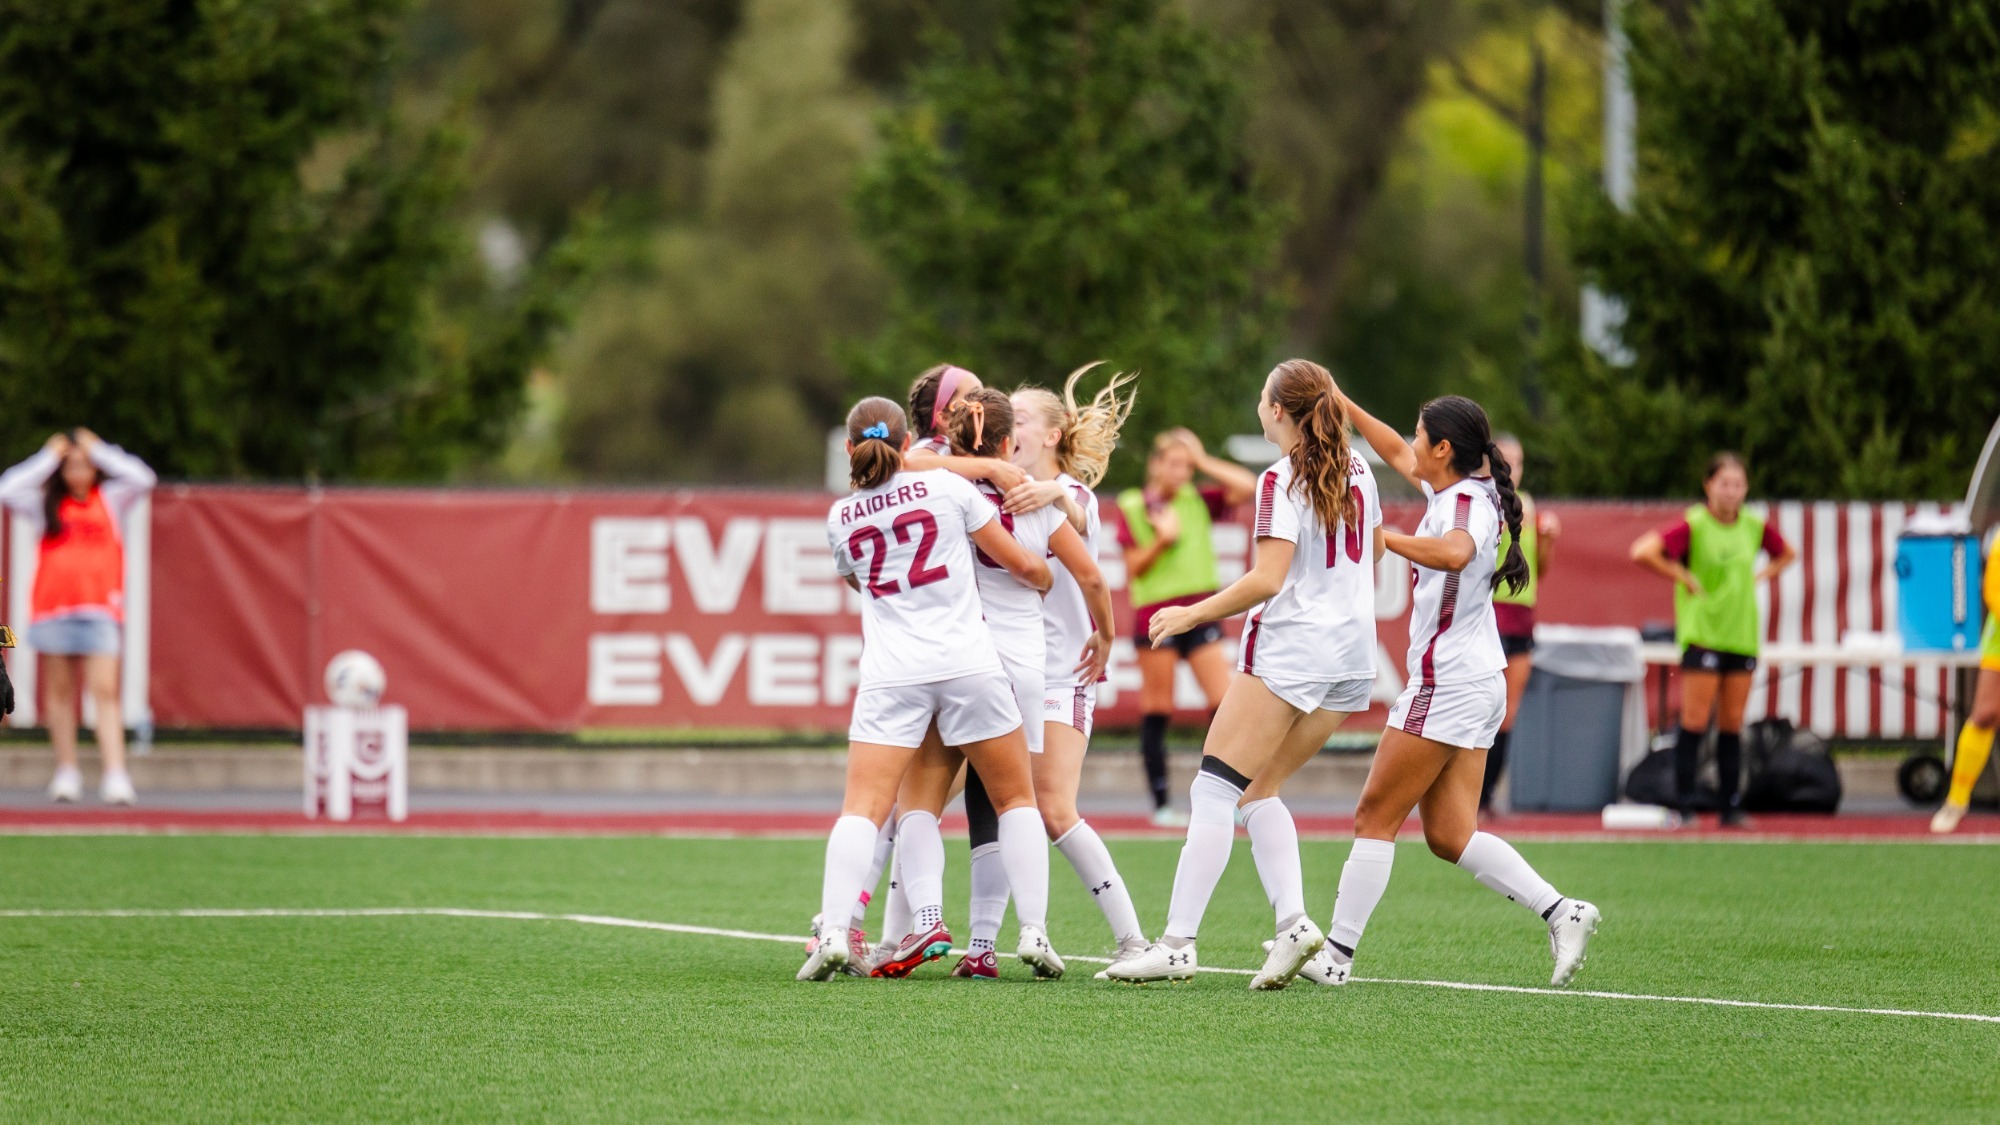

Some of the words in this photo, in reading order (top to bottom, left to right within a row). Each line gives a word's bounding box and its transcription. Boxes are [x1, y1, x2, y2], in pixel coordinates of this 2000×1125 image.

[841, 481, 928, 526] RAIDERS
[590, 517, 862, 615] EVE
[848, 508, 950, 599] 22
